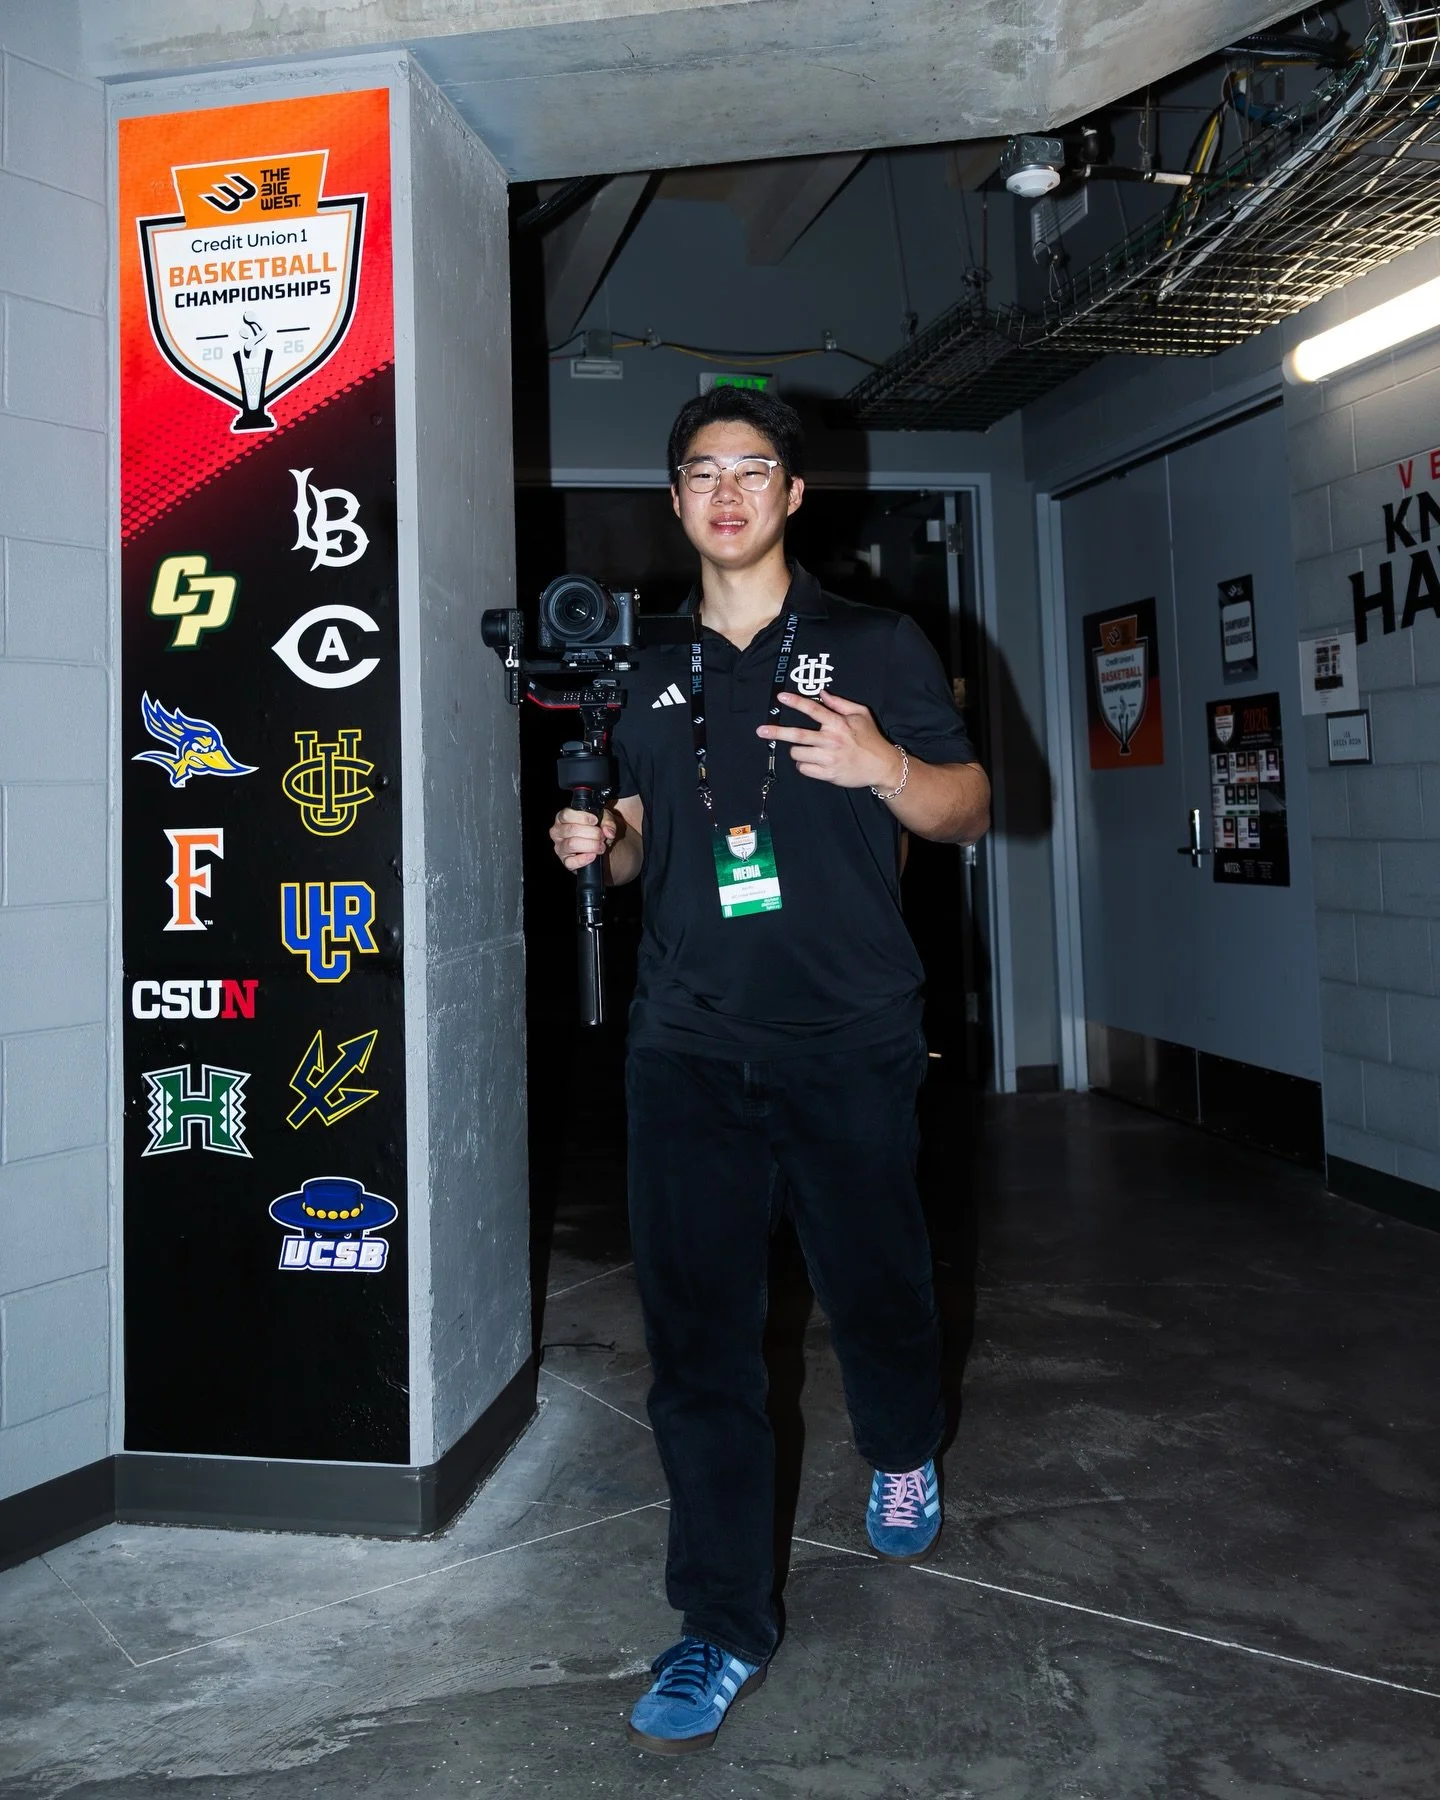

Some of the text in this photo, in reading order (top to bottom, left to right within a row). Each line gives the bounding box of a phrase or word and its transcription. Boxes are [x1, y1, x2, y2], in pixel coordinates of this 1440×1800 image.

[261, 167, 290, 182] THE
[261, 181, 288, 197] BIG
[261, 194, 301, 211] WEST
[191, 235, 243, 254] Credit
[247, 231, 297, 248] Union
[169, 252, 337, 288] BASKETBALL
[175, 279, 331, 308] CHAMPIONSHIPS
[202, 339, 305, 361] 20 26
[150, 553, 239, 649] CP
[781, 634, 795, 653] THE
[691, 655, 702, 673] BIG
[775, 655, 789, 683] BOLD
[1101, 665, 1142, 683] BASKETBALL
[692, 675, 703, 695] THE
[163, 827, 224, 931] F
[732, 864, 761, 882] MEDIA
[131, 979, 259, 1019] CSUN
[280, 1238, 387, 1270] UCSB
